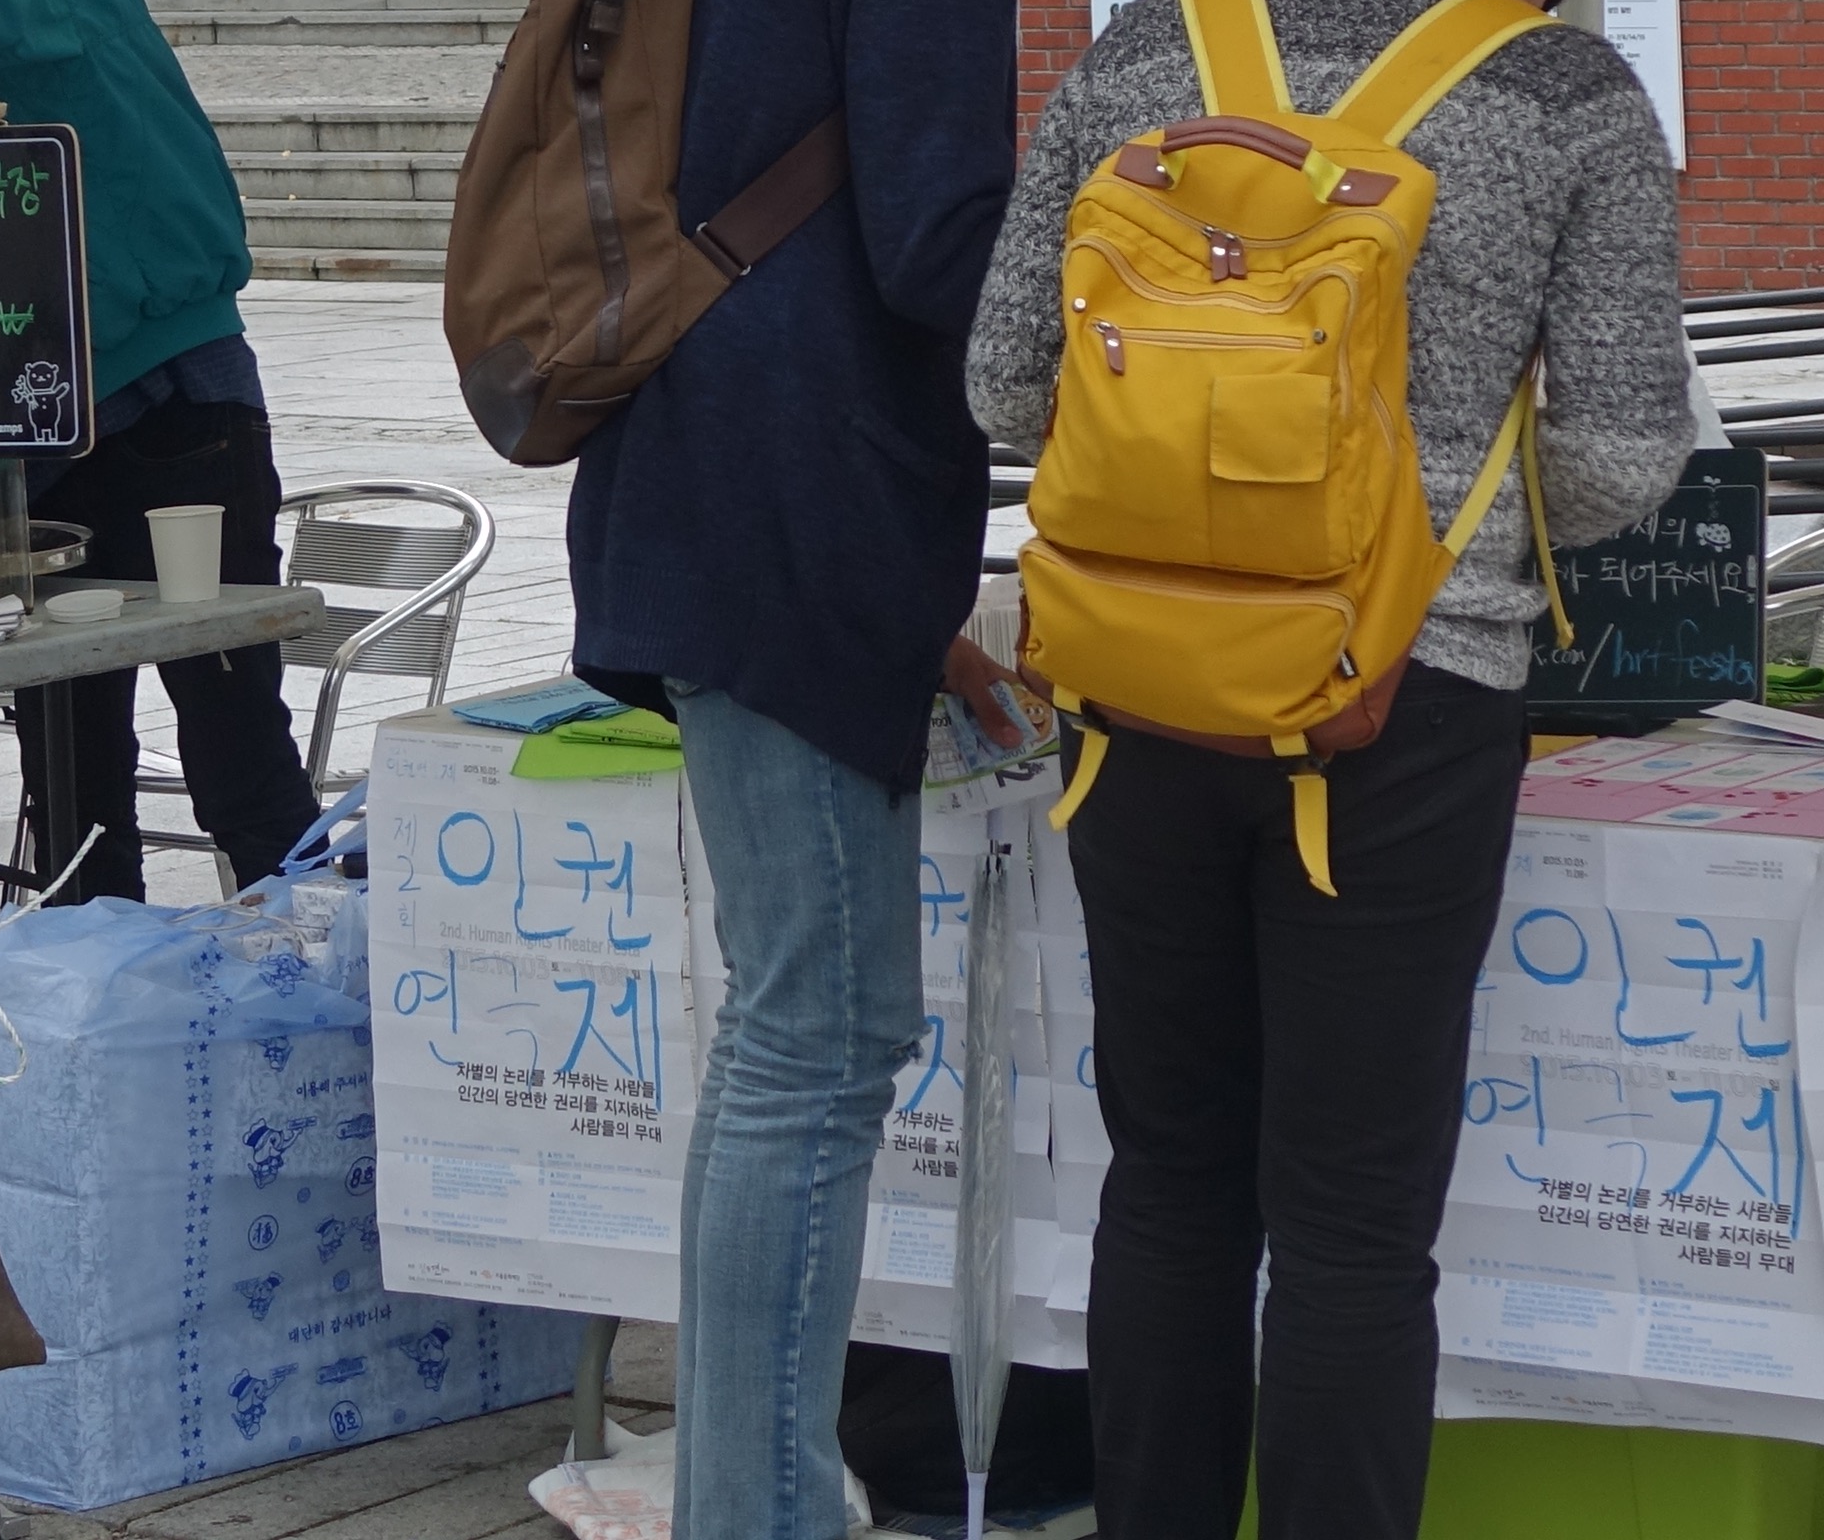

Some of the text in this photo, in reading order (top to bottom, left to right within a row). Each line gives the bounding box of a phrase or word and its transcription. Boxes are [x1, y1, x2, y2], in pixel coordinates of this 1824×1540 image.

[437, 808, 652, 951] 인권
[469, 924, 512, 944] Human
[556, 936, 603, 954] Theater
[1512, 906, 1792, 1057] 인권
[393, 948, 663, 1113] 연극제
[1560, 1028, 1613, 1050] Human
[1675, 1043, 1733, 1062] Theater
[296, 1078, 330, 1099] 이용해
[456, 1062, 497, 1082] 차별의
[503, 1066, 546, 1088] 논리를
[552, 1070, 609, 1093] 거부하는
[458, 1084, 659, 1121] 인간의 당연한 권리를 지지하는
[570, 1117, 663, 1143] 사람들의 무대
[892, 1109, 954, 1134] 거부하는
[892, 1134, 938, 1155] 권리를
[1464, 1055, 1804, 1240] 연극제
[911, 1156, 959, 1178] 사람들
[1538, 1177, 1593, 1203] 차별의
[1596, 1185, 1651, 1212] 논리를
[1658, 1188, 1731, 1218] 거부하는
[1537, 1204, 1793, 1251] 인간의 당연한 권리를 지지하는
[1677, 1244, 1796, 1274] 사람들의 무대
[288, 1304, 392, 1344] 대단히 감사합니다
[333, 1409, 360, 1436] 8호
